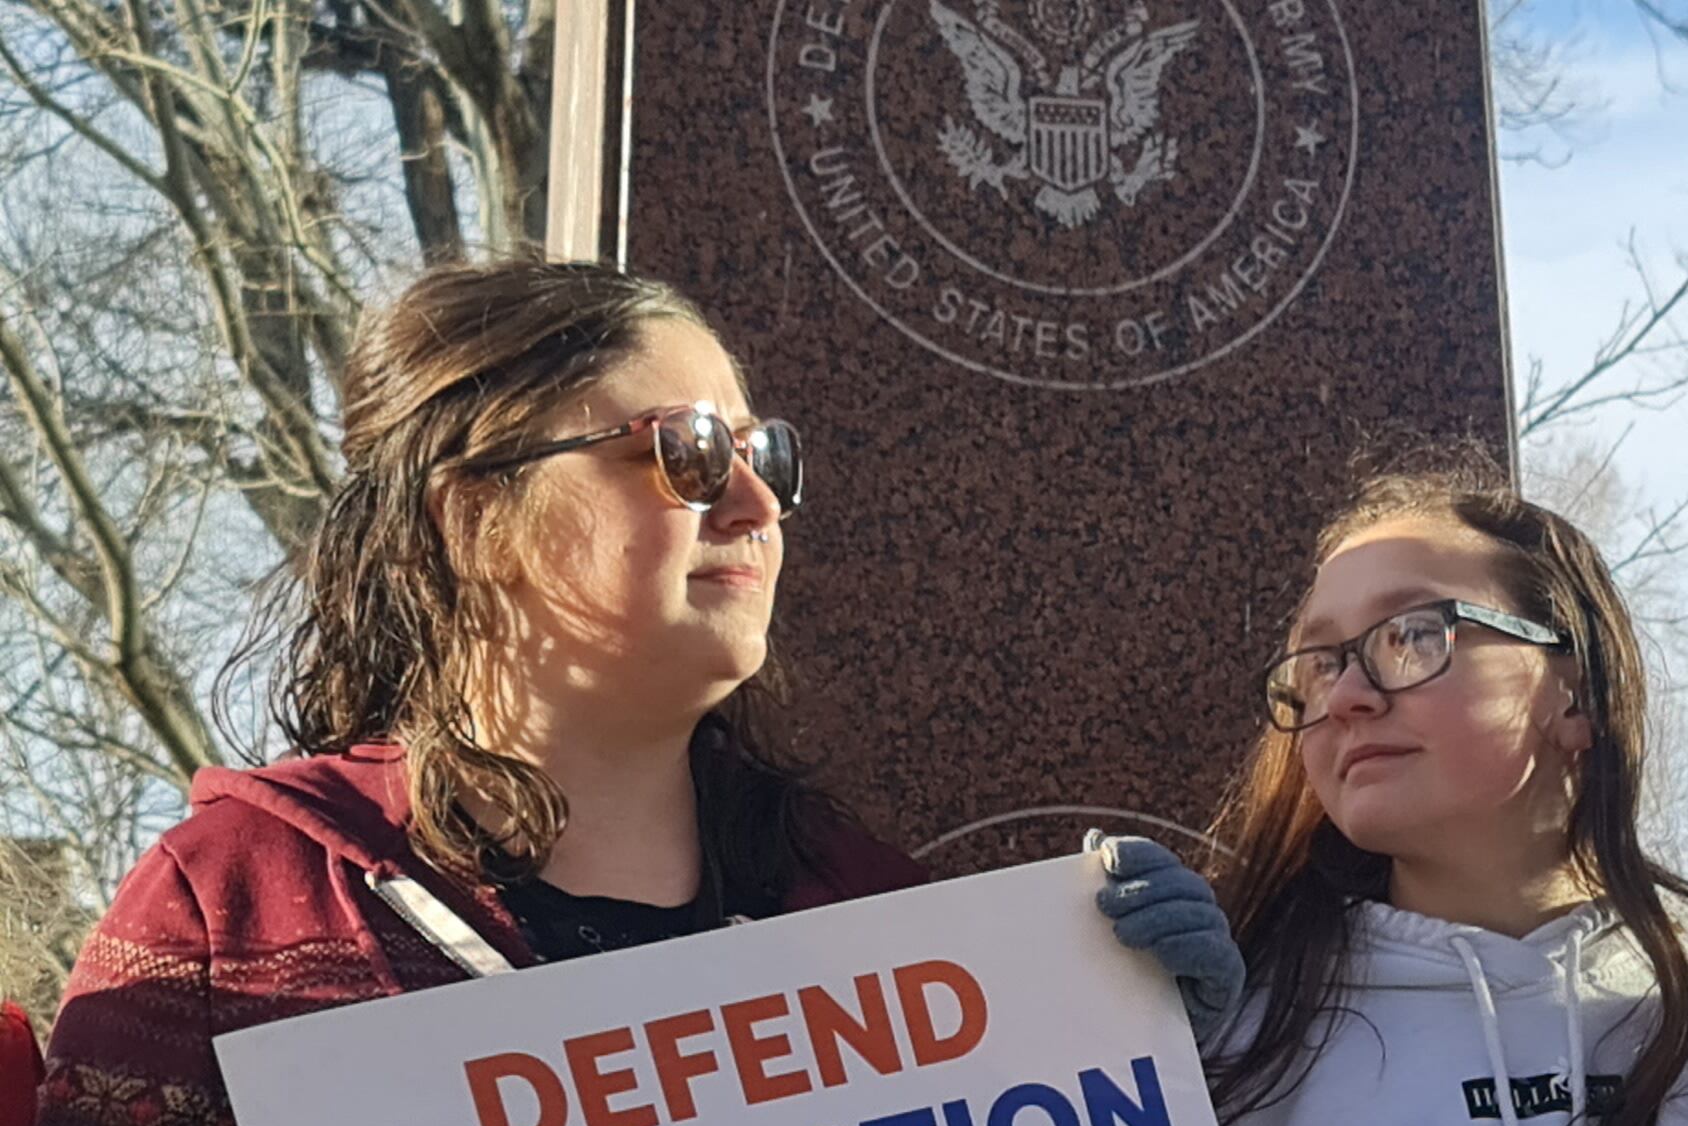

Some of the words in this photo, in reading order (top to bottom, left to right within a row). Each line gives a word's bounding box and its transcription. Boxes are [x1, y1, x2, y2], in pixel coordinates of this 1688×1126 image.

[809, 146, 919, 289] UNITED
[932, 288, 1090, 360] STATES
[1115, 310, 1165, 356] OF
[1186, 178, 1320, 333] AMERICA
